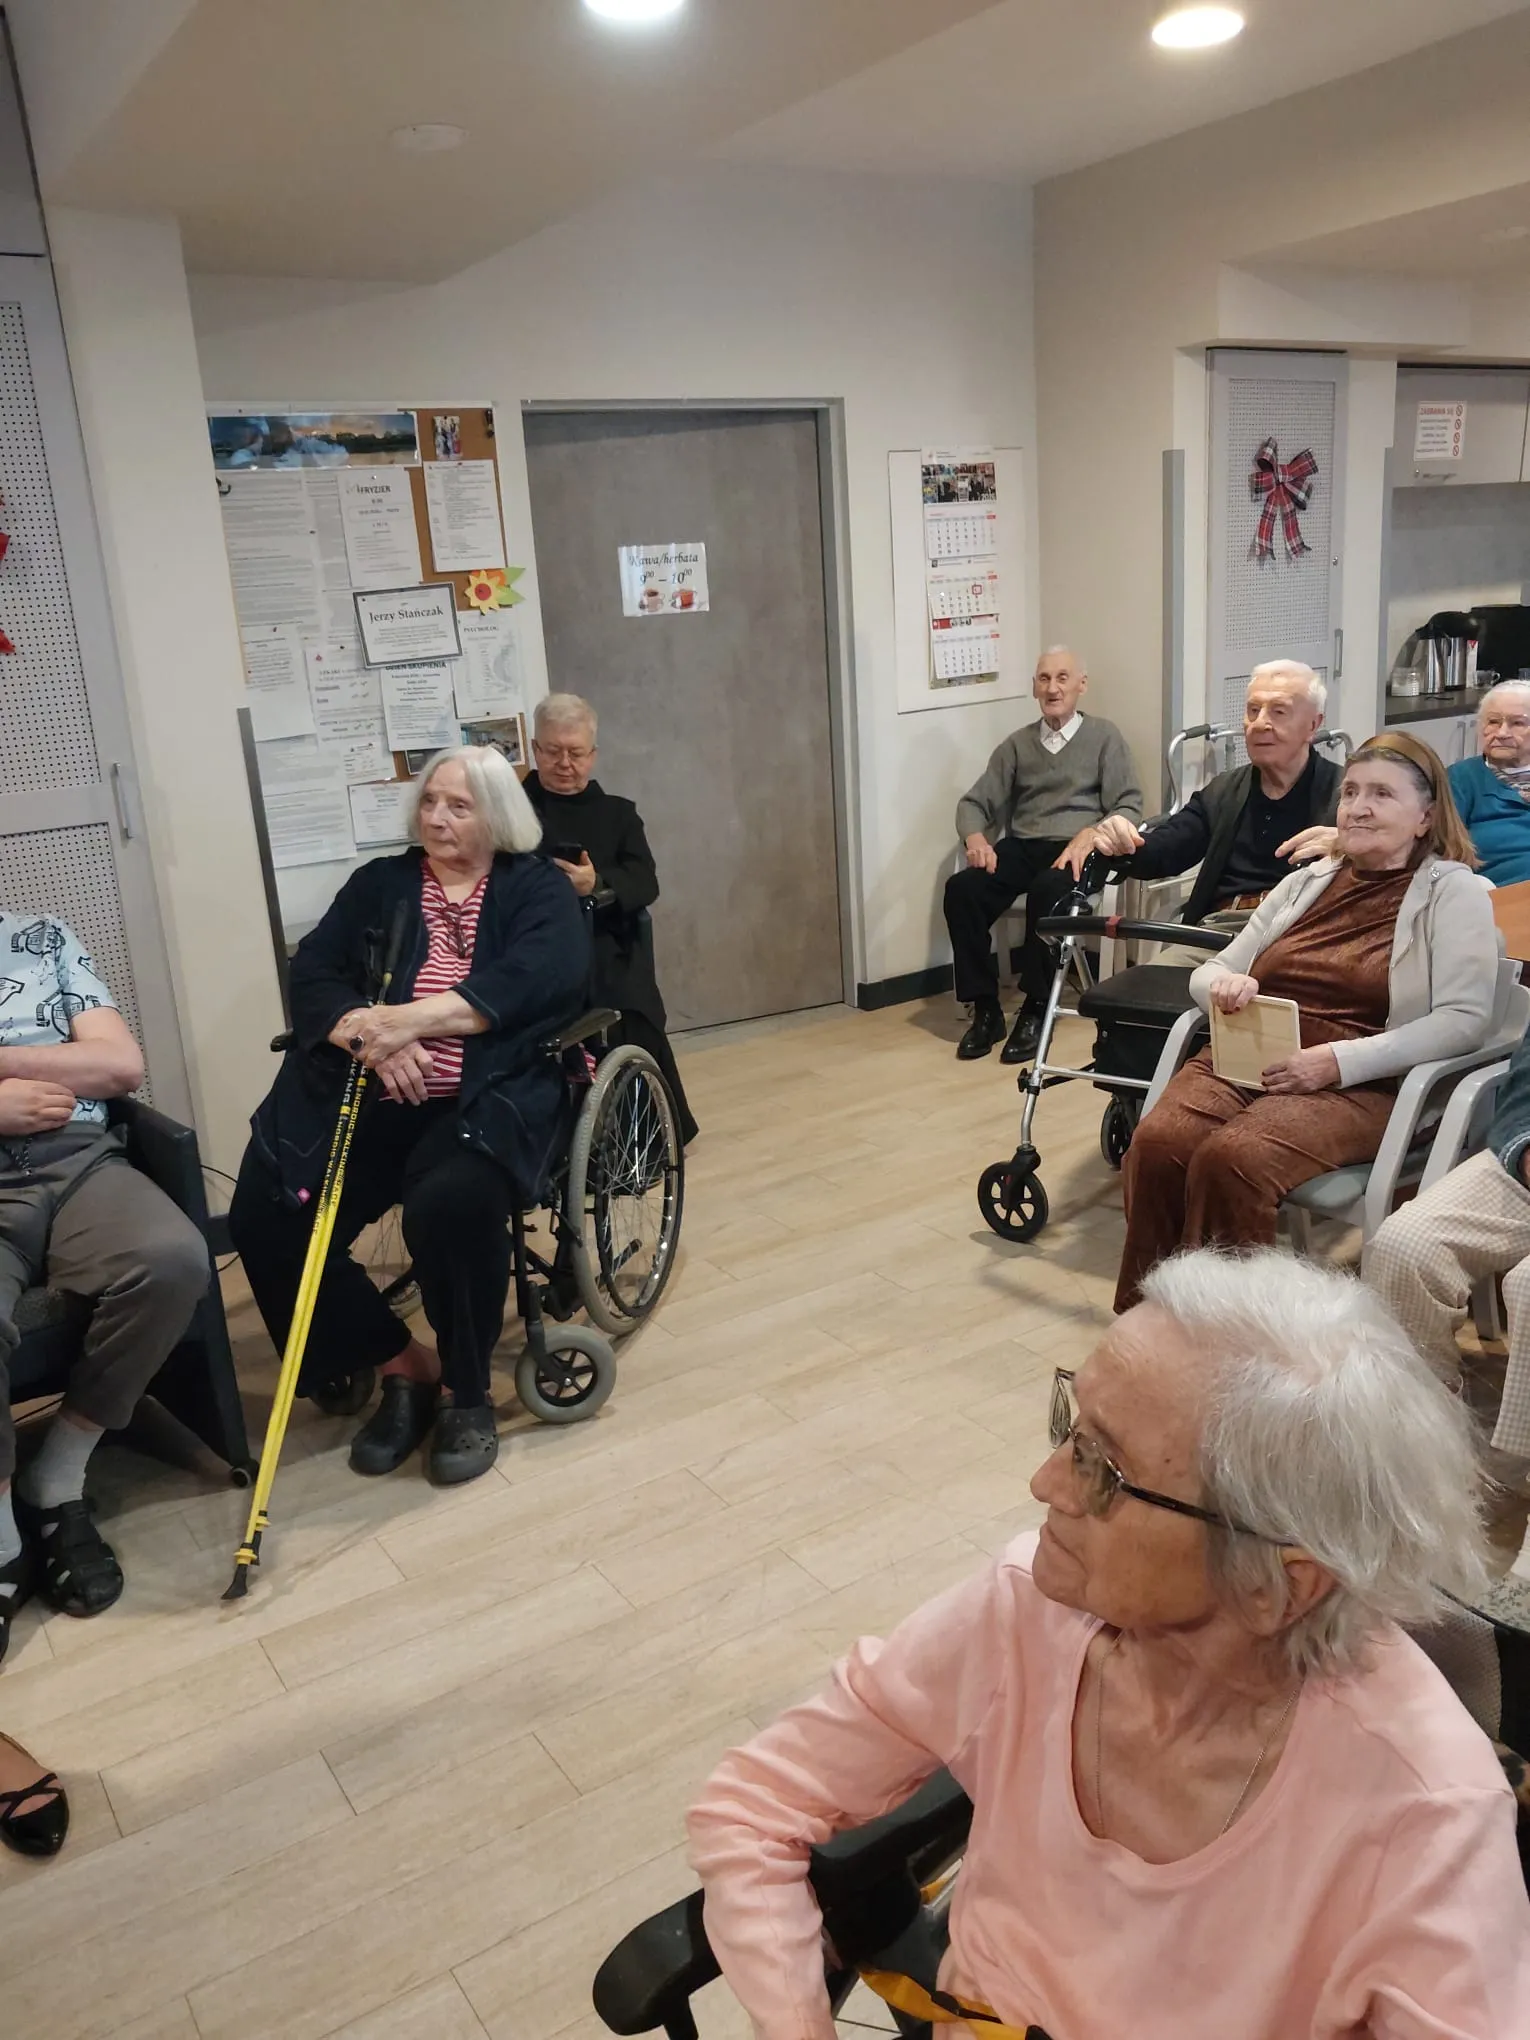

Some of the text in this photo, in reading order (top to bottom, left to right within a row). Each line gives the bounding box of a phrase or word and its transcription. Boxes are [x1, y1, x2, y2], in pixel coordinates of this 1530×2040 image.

[369, 611, 395, 624] Jerzy
[348, 1093, 362, 1130] NORDIC
[337, 1132, 353, 1176] WALKING
